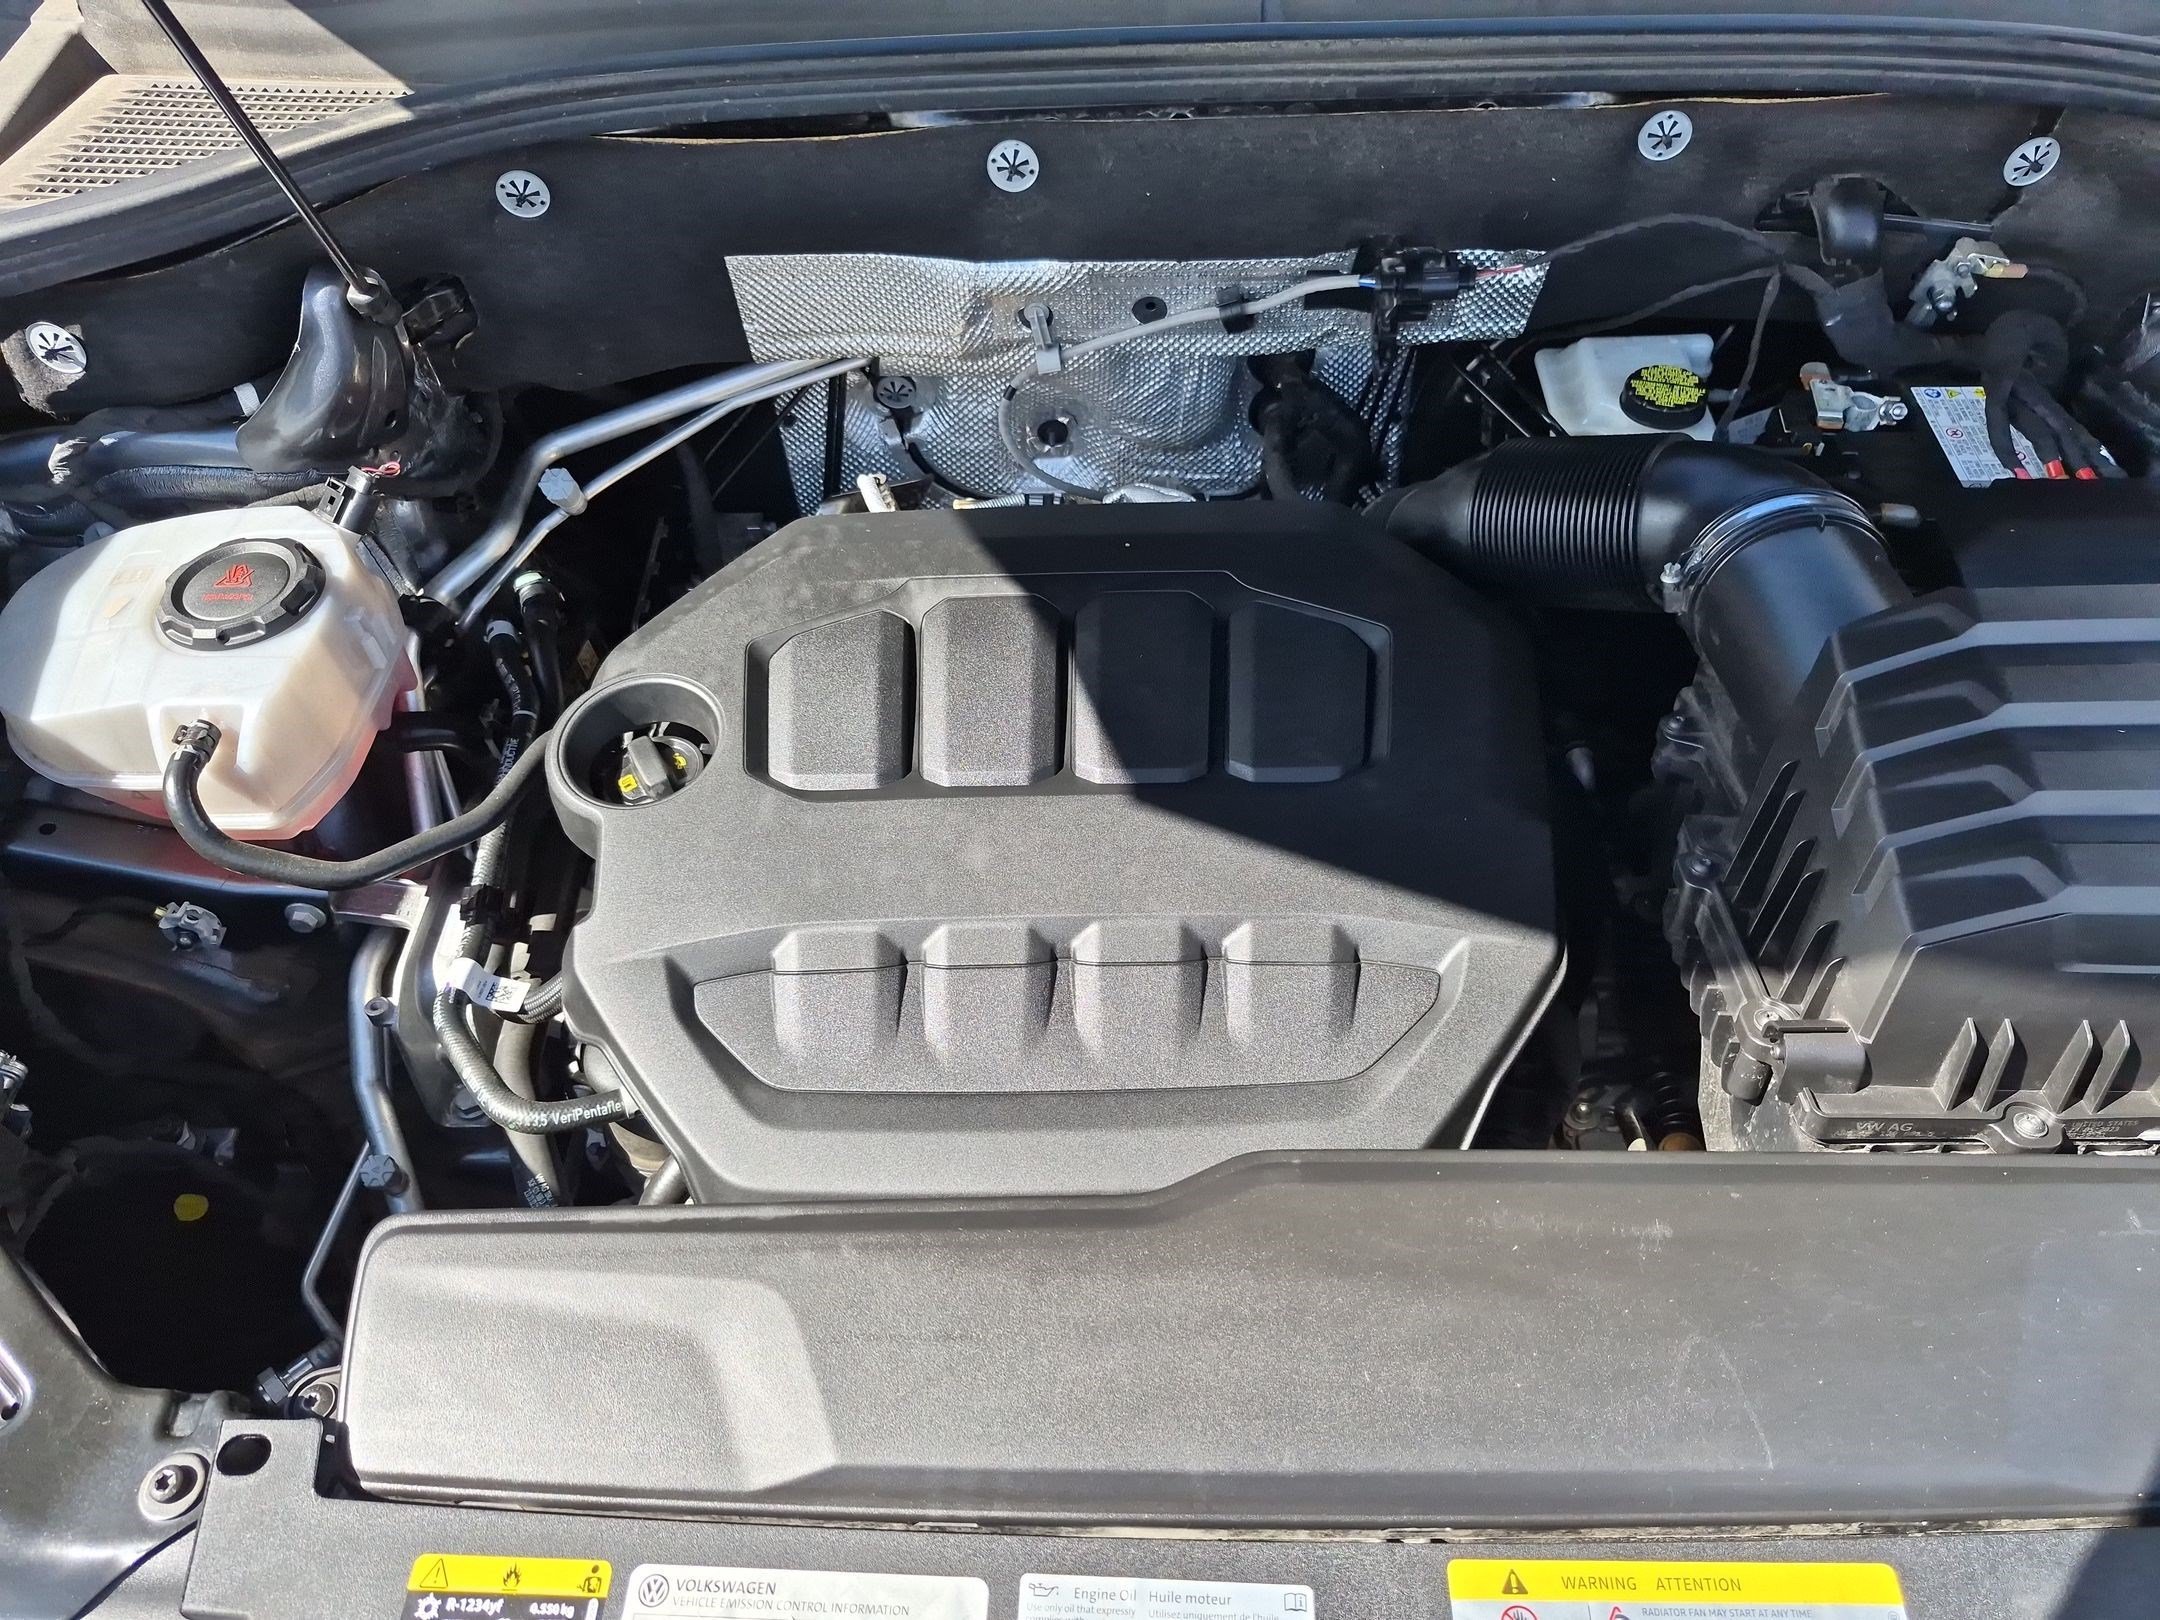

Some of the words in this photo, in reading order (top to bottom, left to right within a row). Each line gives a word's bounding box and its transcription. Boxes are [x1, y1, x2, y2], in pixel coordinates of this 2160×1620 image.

[551, 1100, 625, 1126] VeriPentafle
[1887, 1122, 1914, 1132] AG
[676, 1578, 777, 1596] VOLKSWAGEN
[1561, 1576, 1637, 1591] WARNING
[1656, 1577, 1742, 1592] ATTENTION
[1074, 1587, 1116, 1603] Engine
[1119, 1589, 1137, 1602] Oil
[1149, 1591, 1182, 1604] Huile
[1185, 1593, 1233, 1606] moteur
[444, 1598, 505, 1616] R-1234yf
[560, 1604, 575, 1618] kg
[673, 1596, 716, 1609] VEHICLE
[719, 1598, 774, 1611] EMISSION
[776, 1600, 828, 1614] CONTROL
[831, 1602, 910, 1616] INFORMATION
[1026, 1602, 1042, 1611] Use
[1044, 1603, 1063, 1614] only
[1064, 1603, 1075, 1613] oil
[1076, 1605, 1095, 1614] that
[1096, 1607, 1136, 1619] expressly
[1641, 1607, 1686, 1617] RADIATOR
[1688, 1608, 1706, 1617] FAN
[1707, 1608, 1727, 1617] MAY
[1729, 1609, 1757, 1618] START
[1758, 1609, 1769, 1618] AT
[1770, 1609, 1789, 1618] ANY
[1790, 1609, 1812, 1618] TIME
[1148, 1609, 1181, 1619] Utilisez
[1239, 1611, 1251, 1620] de
